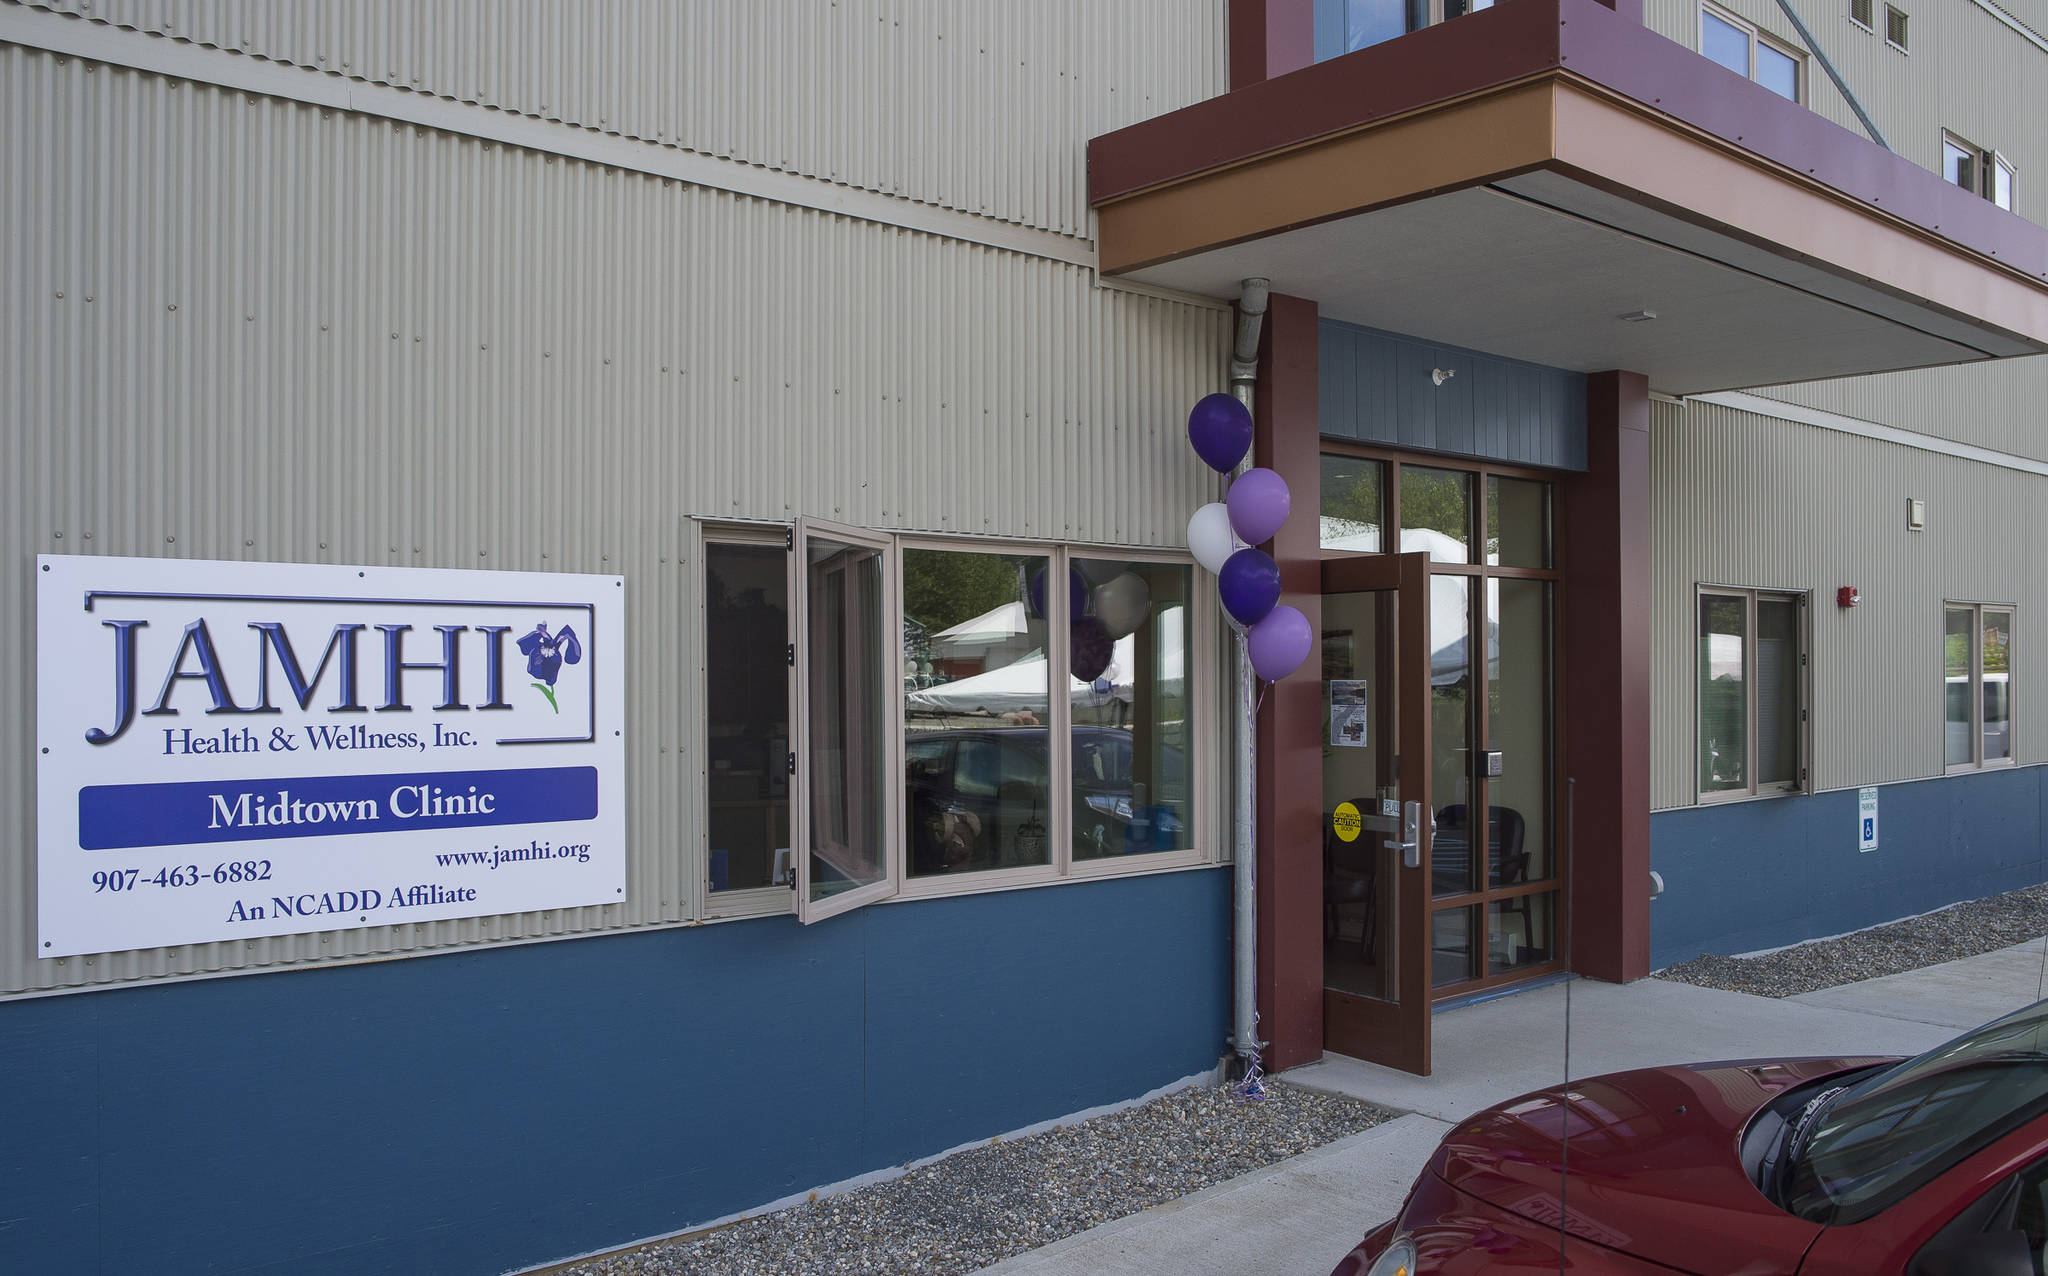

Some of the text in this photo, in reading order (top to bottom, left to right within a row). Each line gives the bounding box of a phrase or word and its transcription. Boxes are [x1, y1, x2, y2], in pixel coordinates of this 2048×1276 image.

[85, 618, 514, 746] JAMHI
[162, 723, 479, 755] Health & Wellness, Inc.
[207, 785, 496, 829] Midtown Clinic
[1333, 817, 1361, 828] CAUTION
[435, 841, 592, 870] www.jamhi.org
[92, 859, 273, 894] 907-463-6882
[226, 884, 478, 923] An NCADD Affiliate
